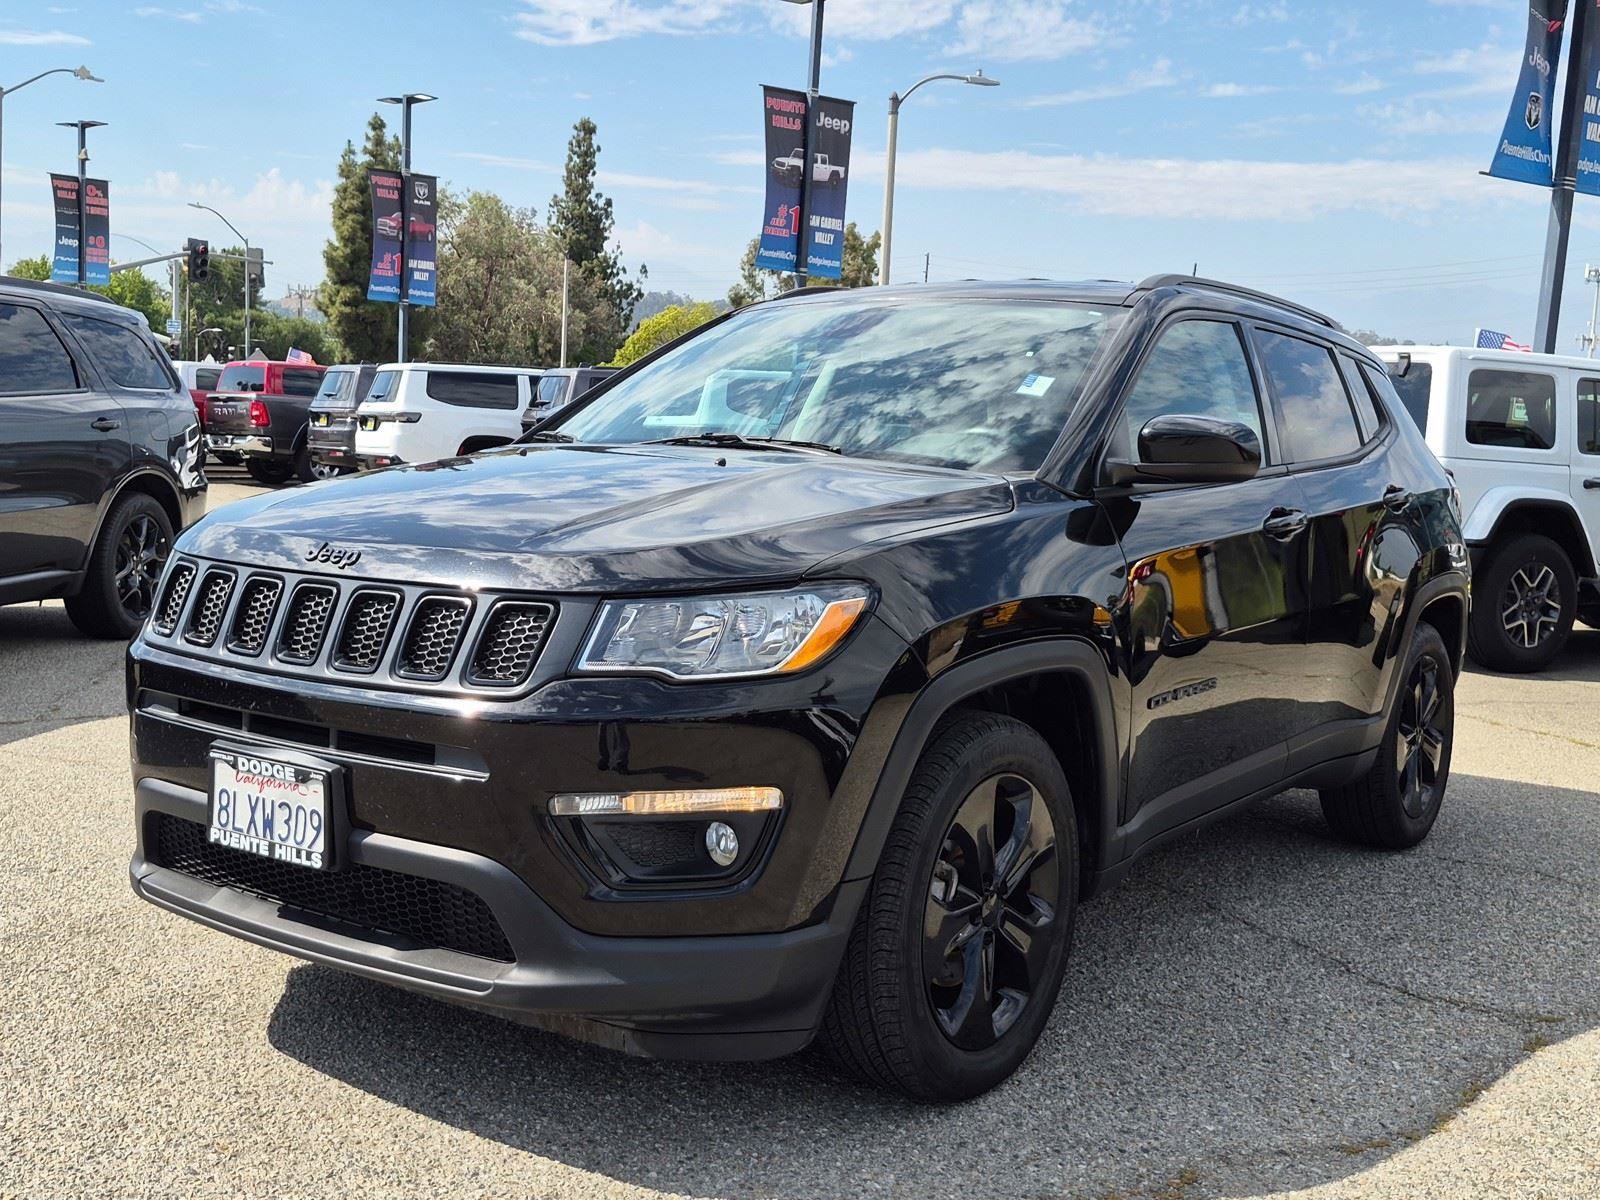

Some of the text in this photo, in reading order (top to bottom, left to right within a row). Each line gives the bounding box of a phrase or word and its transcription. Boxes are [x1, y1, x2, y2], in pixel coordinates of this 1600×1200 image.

[766, 97, 805, 114] PUENTE
[1584, 94, 1597, 115] AN
[772, 115, 802, 131] HILLS
[816, 111, 850, 134] Jeep
[58, 235, 80, 247] Jeep
[304, 541, 362, 570] Jeep
[237, 756, 296, 782] DODGE
[217, 787, 323, 850] 8LXW309
[209, 827, 323, 870] PUENTE HILLS
